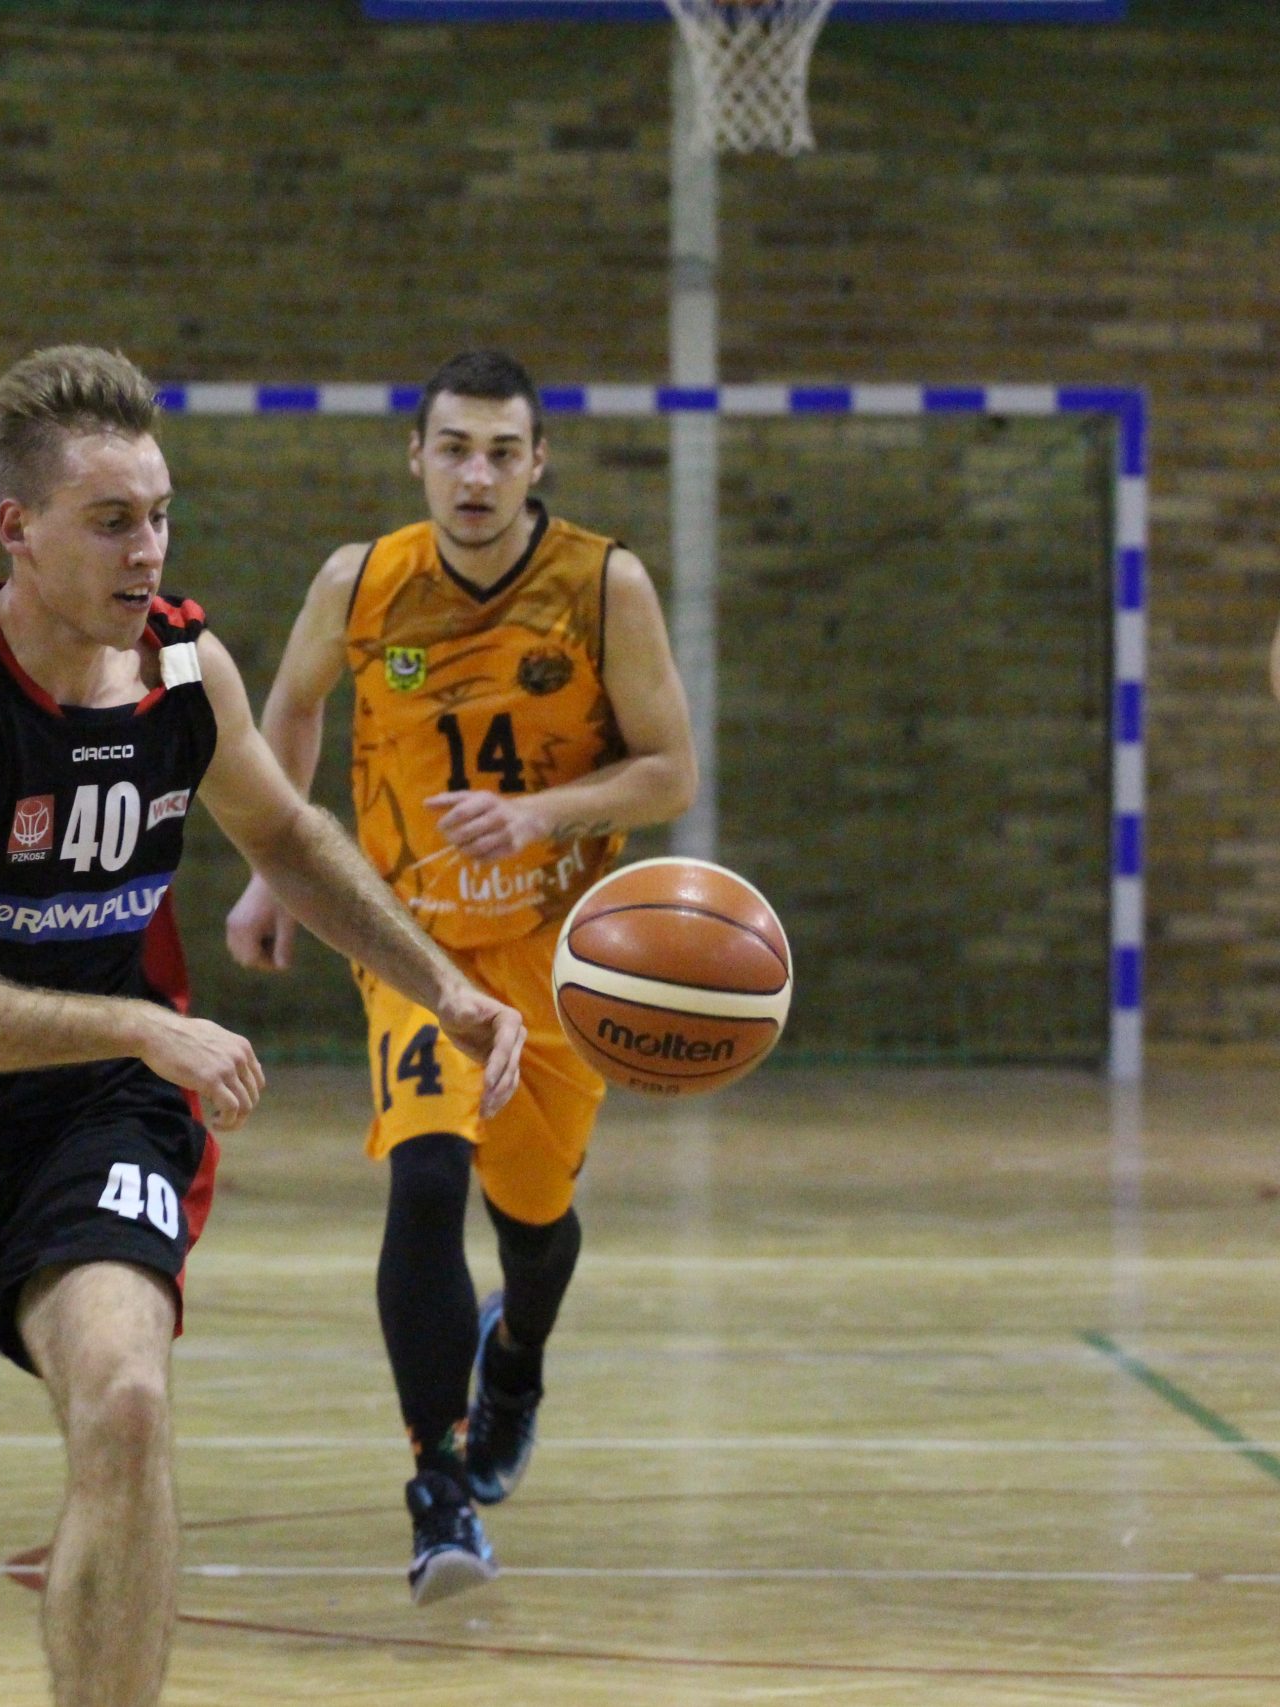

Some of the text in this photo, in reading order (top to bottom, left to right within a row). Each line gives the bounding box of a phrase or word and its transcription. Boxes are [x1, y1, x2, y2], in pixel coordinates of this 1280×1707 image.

[437, 712, 526, 793] 14
[11, 851, 46, 863] PZKOSZ
[59, 780, 141, 873] 40
[379, 1024, 444, 1113] 14
[598, 1017, 736, 1063] molten
[97, 1162, 180, 1241] 40
